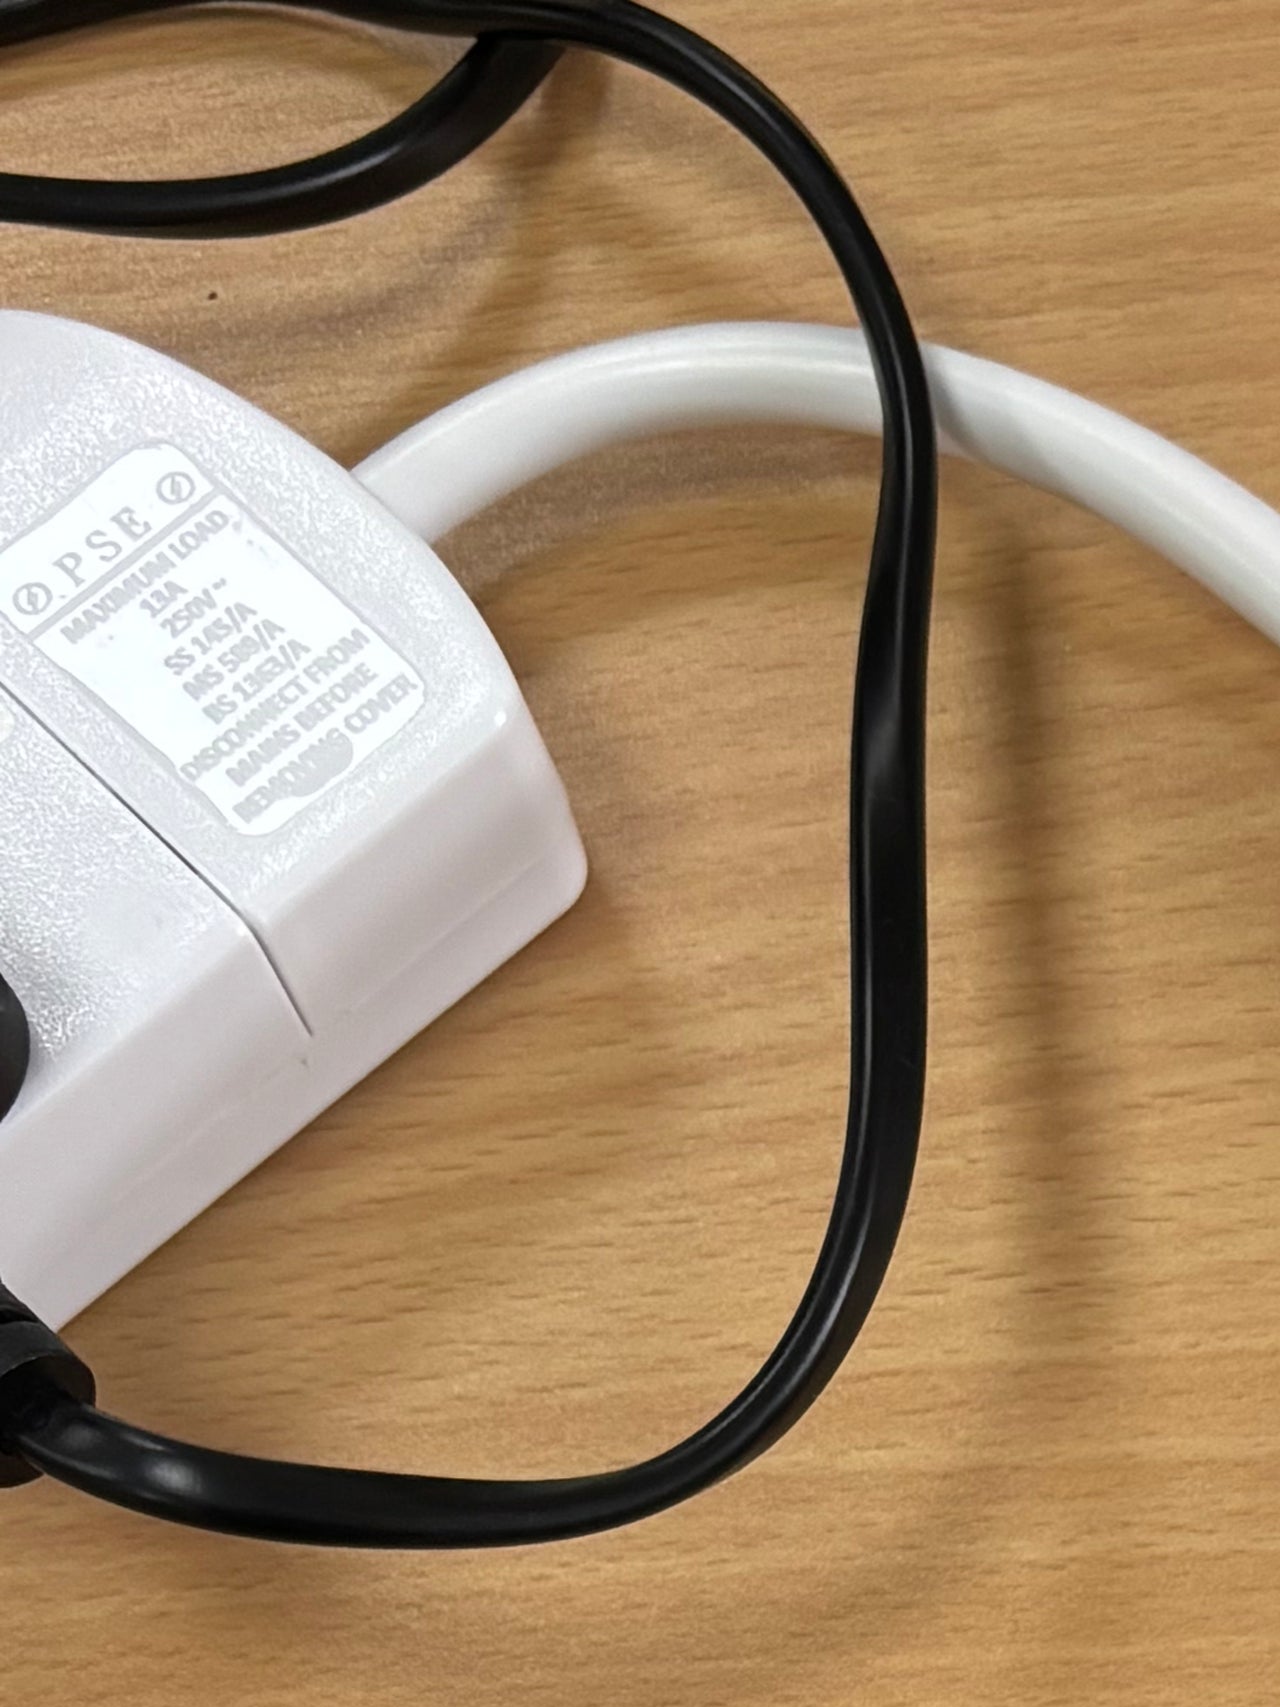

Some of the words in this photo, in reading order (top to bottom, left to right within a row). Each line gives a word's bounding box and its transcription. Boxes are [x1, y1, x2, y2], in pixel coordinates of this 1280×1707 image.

[52, 507, 152, 588] PSE
[60, 552, 176, 644] MAXIMUM
[168, 510, 229, 560] LOAD
[140, 581, 188, 618] 13A
[160, 588, 214, 638] 250V
[164, 647, 195, 676] SS
[182, 664, 224, 701] MS
[179, 676, 309, 782] DISCONNECT
[303, 629, 370, 684] FROM
[225, 724, 301, 786] MAINS
[294, 663, 378, 731] BEFORE
[344, 674, 418, 733] COVER
